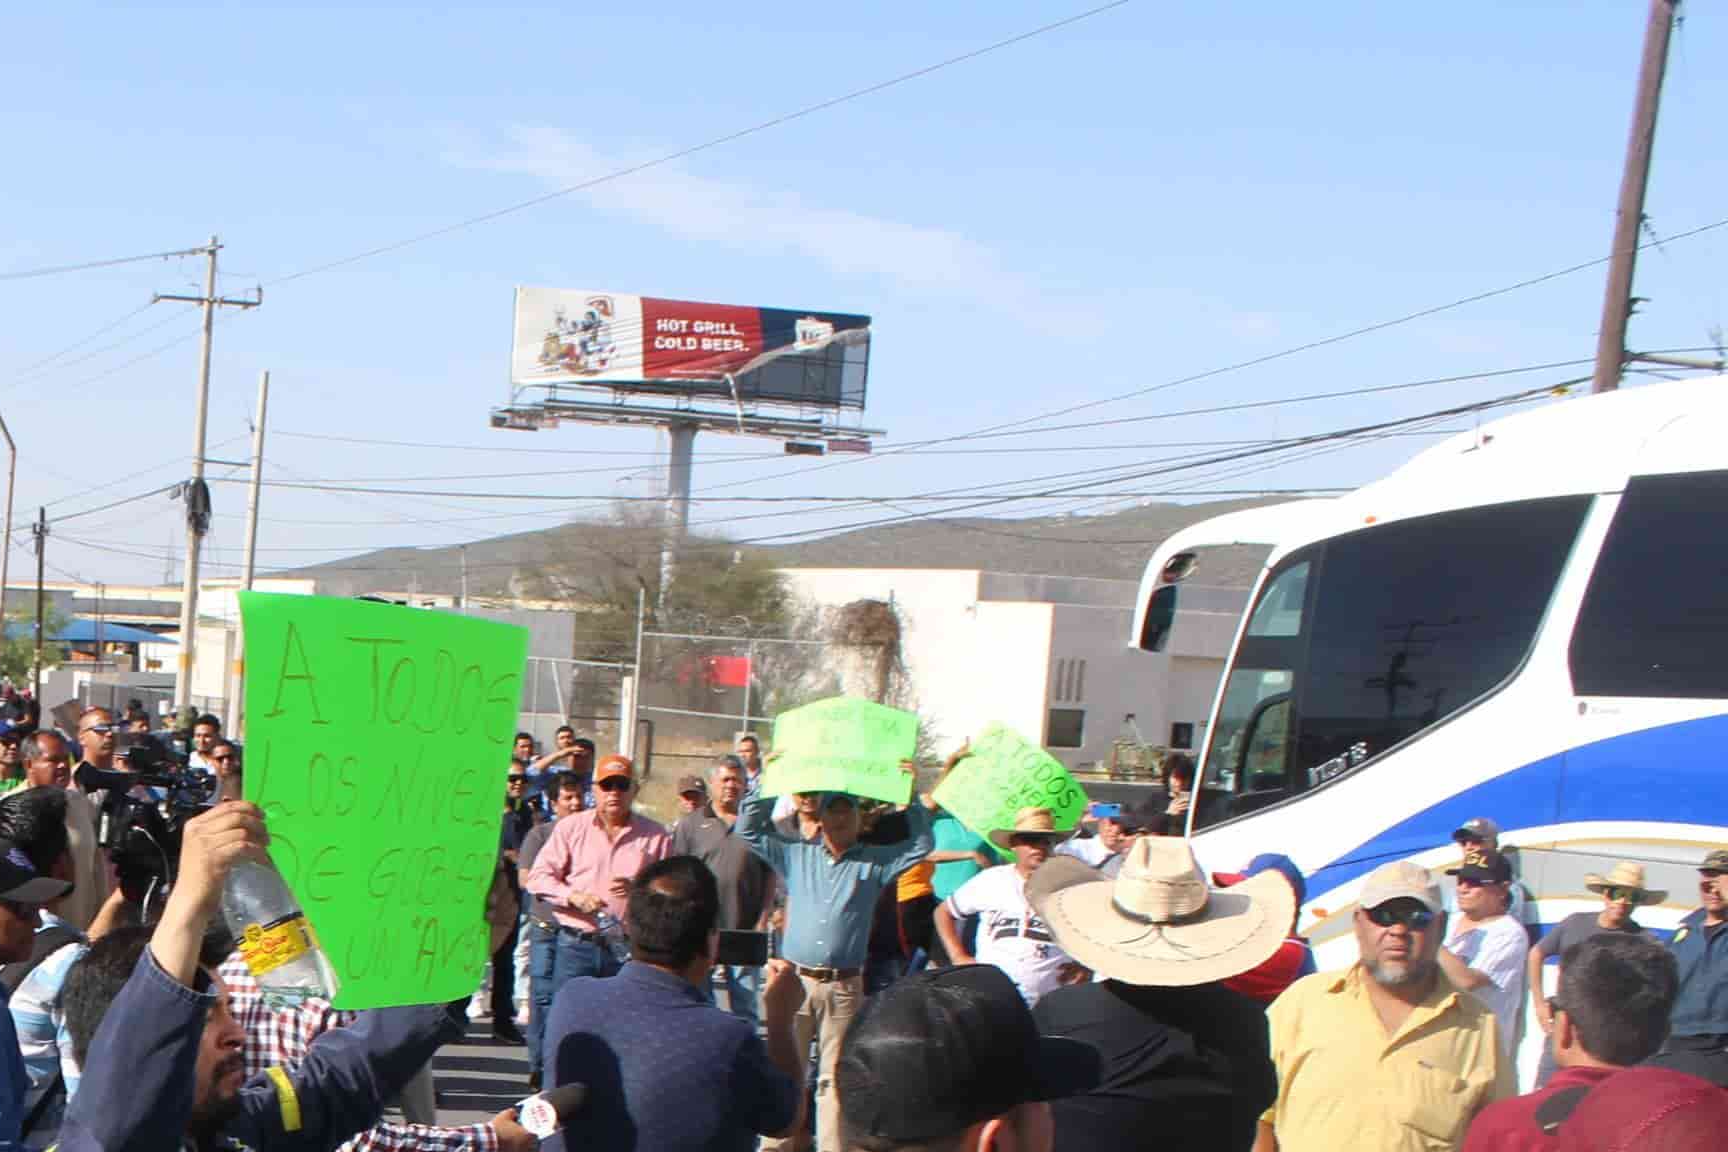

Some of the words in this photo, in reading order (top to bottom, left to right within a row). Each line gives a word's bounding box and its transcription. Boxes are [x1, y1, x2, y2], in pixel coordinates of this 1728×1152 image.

[656, 319, 688, 333] HOT
[654, 336, 696, 350] COLD
[264, 620, 331, 725] A
